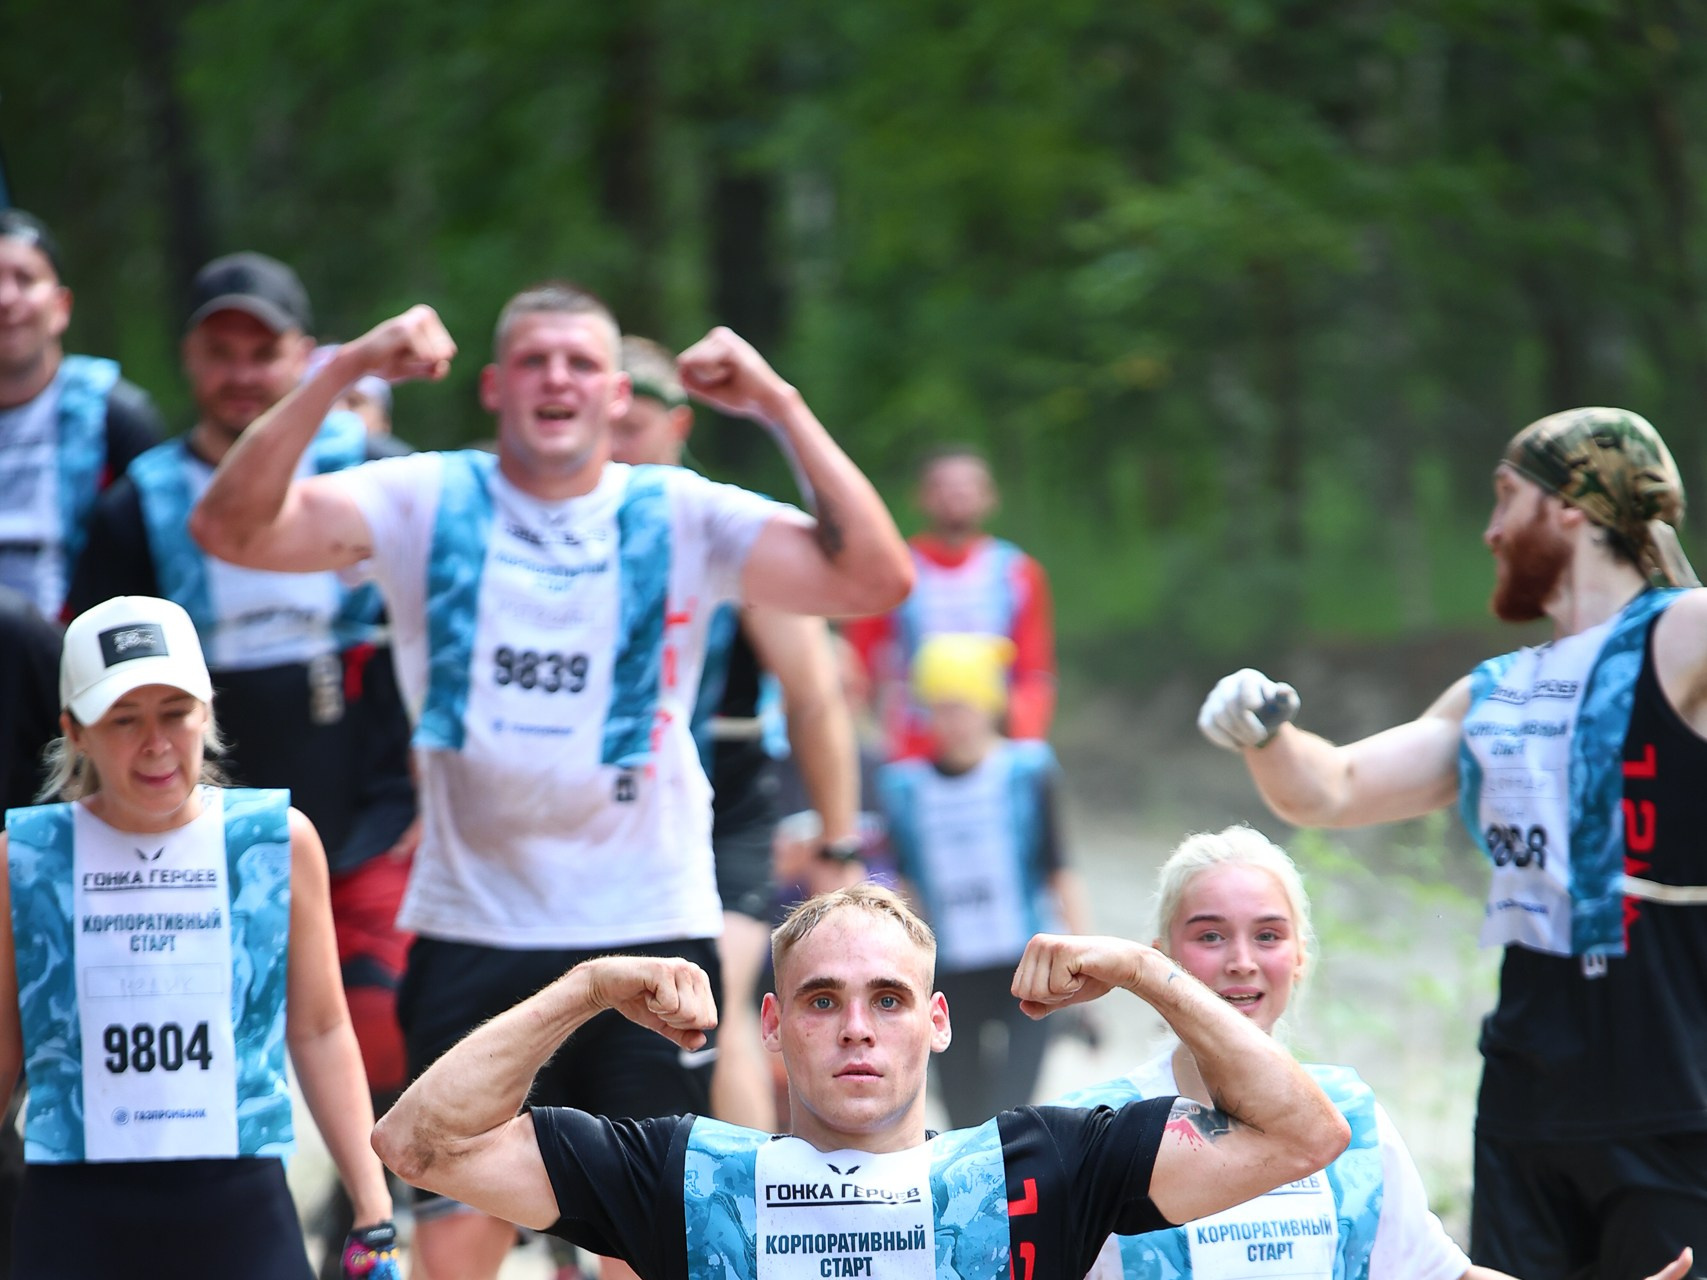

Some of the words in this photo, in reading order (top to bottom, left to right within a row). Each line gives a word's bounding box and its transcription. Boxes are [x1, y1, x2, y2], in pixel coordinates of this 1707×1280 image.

[495, 646, 590, 693] 9839
[83, 870, 143, 886] ГОНКА
[149, 869, 217, 883] ГЕРОЕВ
[82, 907, 222, 932] КОРПОРАТИВНЫЙ
[130, 934, 176, 952] СТАРТ
[103, 1021, 213, 1074] 9804
[765, 1183, 834, 1201] ГОНКА
[841, 1183, 920, 1200] ГЕРОЕВ
[765, 1224, 926, 1254] КОРПОРАТИВНЫЙ
[1195, 1214, 1333, 1245] КОРПОРАТИВНЫЙ
[1247, 1241, 1294, 1262] СТАРТ
[819, 1257, 873, 1278] СТАРТ
